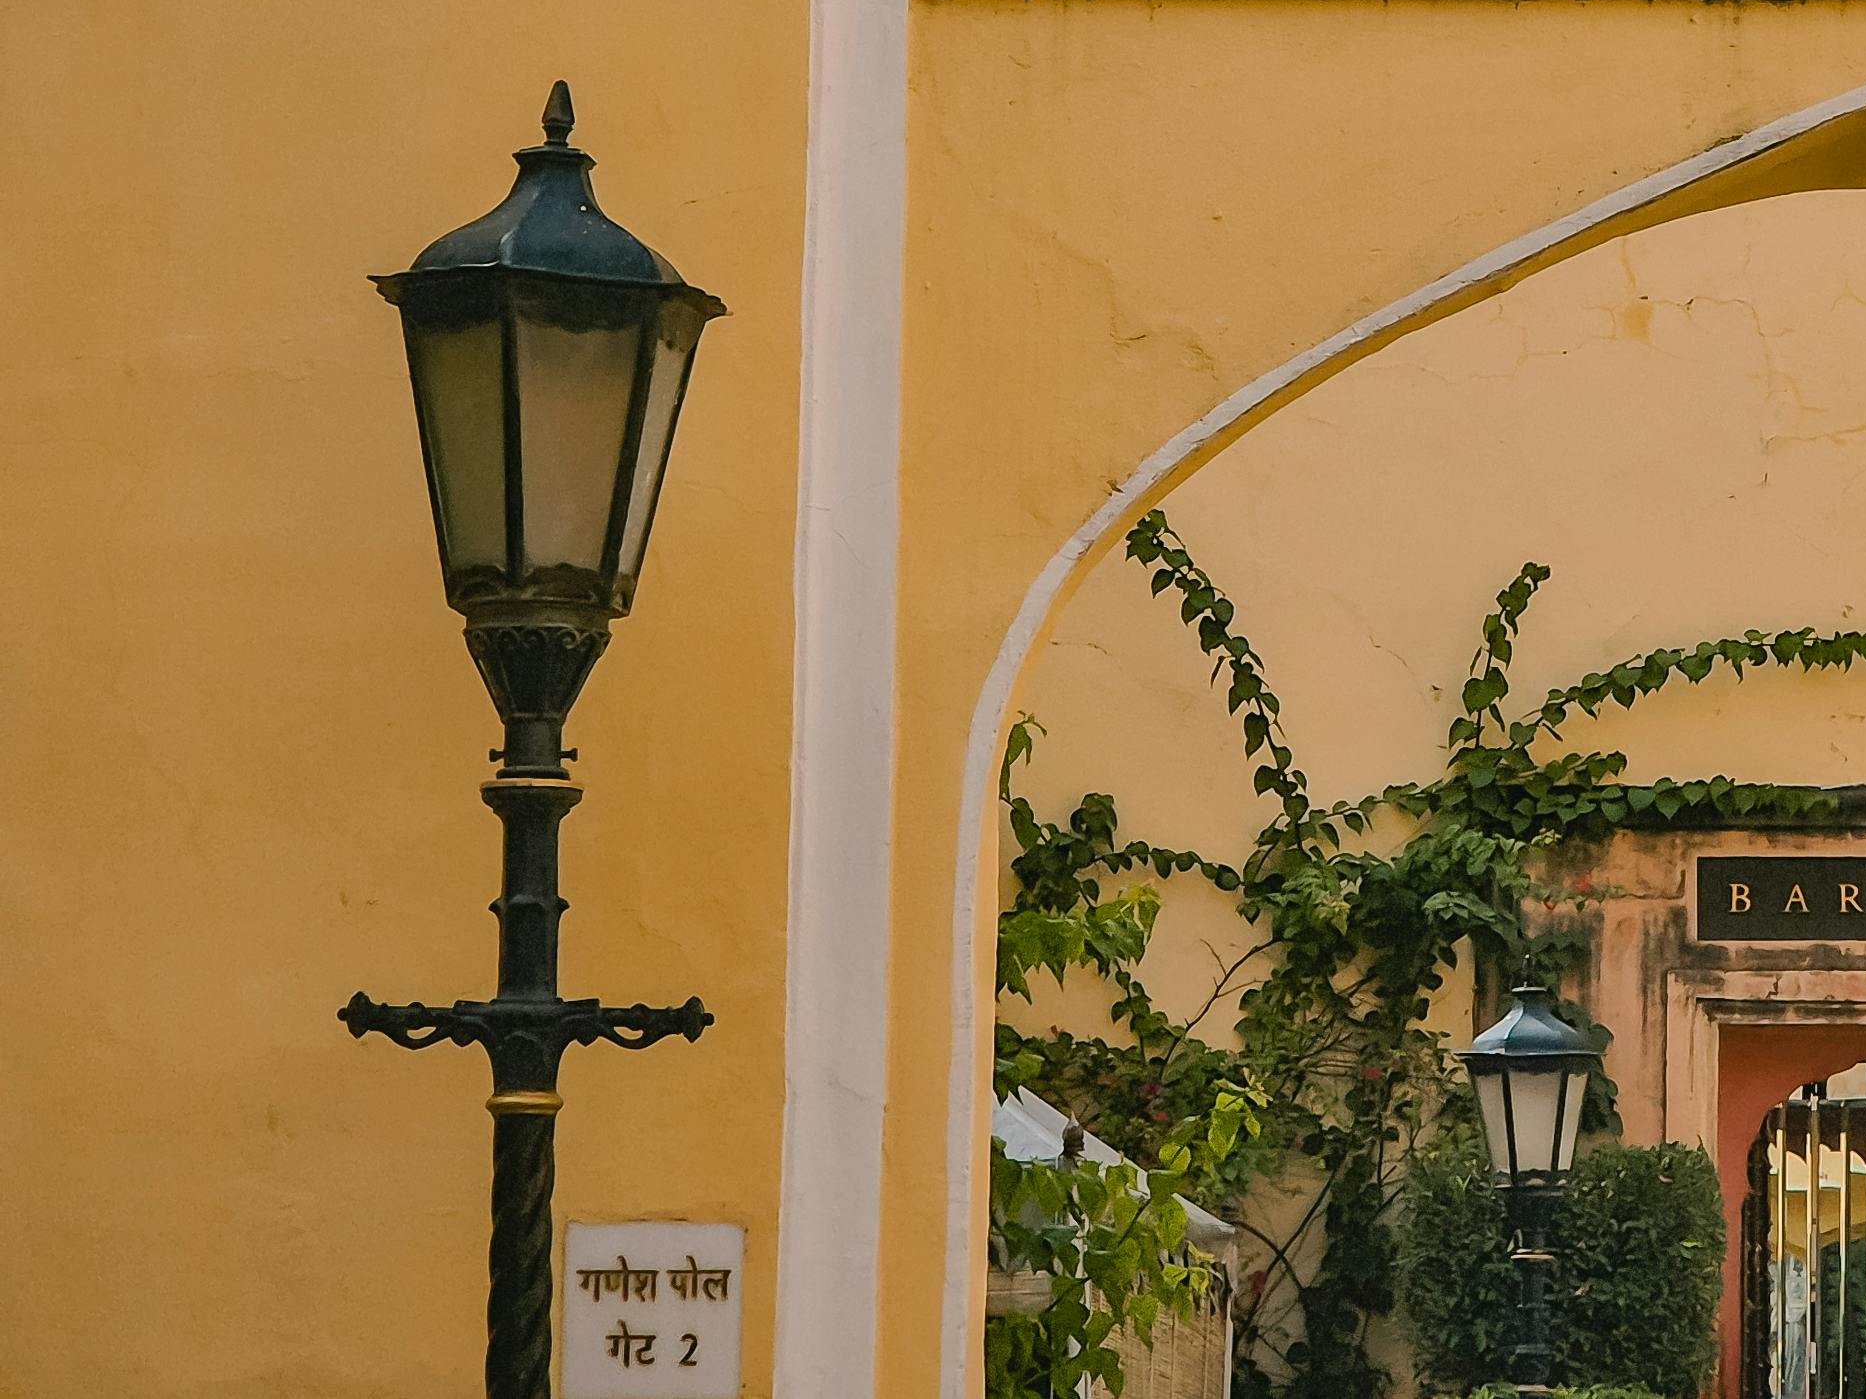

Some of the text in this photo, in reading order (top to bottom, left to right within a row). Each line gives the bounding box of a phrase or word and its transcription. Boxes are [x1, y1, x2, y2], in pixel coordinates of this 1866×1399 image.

[576, 1255, 732, 1303] गणेश पोल
[605, 1319, 699, 1369] गेट 2
